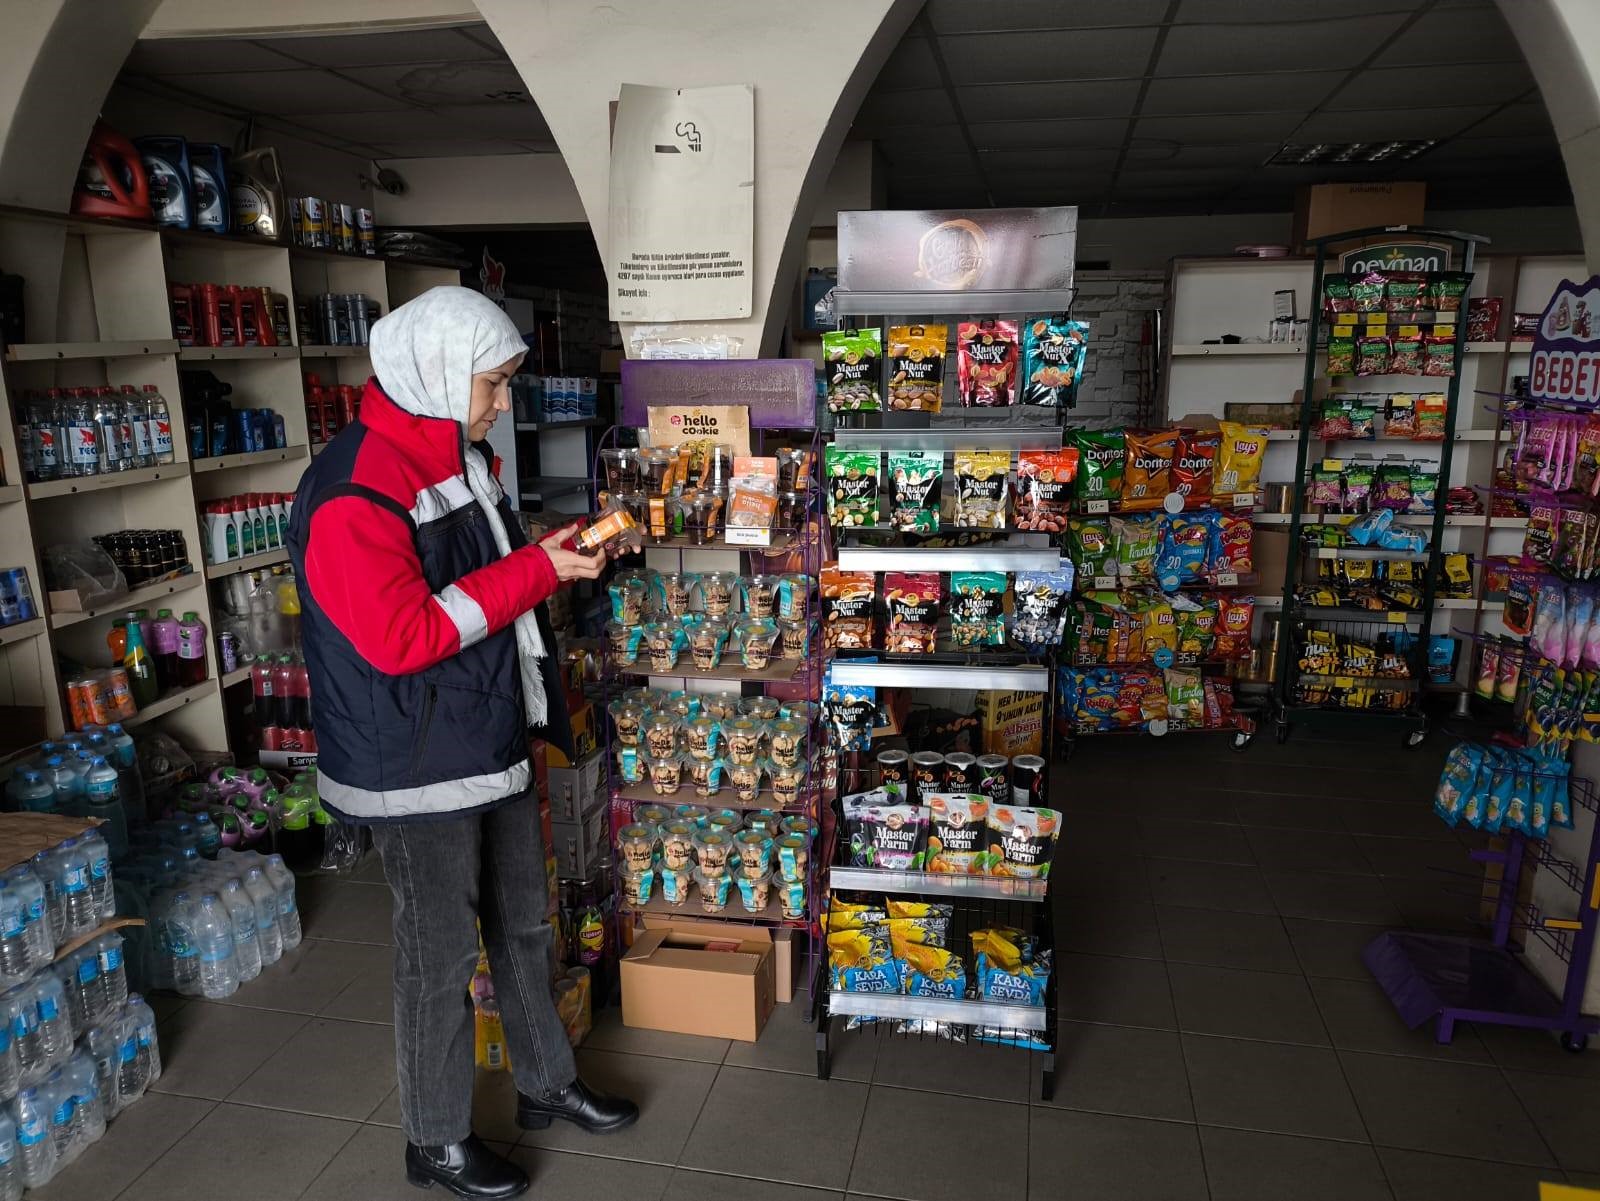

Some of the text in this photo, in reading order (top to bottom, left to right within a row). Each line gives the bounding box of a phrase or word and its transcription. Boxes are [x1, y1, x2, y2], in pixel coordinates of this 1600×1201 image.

[1352, 256, 1440, 273] peyman
[970, 344, 1006, 354] Master
[1038, 344, 1074, 354] Master
[836, 362, 869, 373] Master
[899, 360, 933, 372] Master
[846, 370, 862, 379] Nut
[908, 368, 925, 379] Nut
[1533, 356, 1600, 397] BEBET
[683, 414, 717, 426] hello
[682, 426, 719, 435] cookie
[1088, 449, 1125, 460] Doritos
[1180, 458, 1213, 468] Dorito
[1224, 470, 1238, 485] 20
[838, 479, 870, 490] Master
[965, 478, 998, 490] Master
[1088, 476, 1104, 492] 20
[1132, 484, 1146, 496] 20
[846, 487, 862, 496] Nut
[973, 487, 990, 496] Nut
[1038, 490, 1054, 500] Nut
[1081, 561, 1094, 576] 20
[1166, 556, 1182, 570] 20
[1218, 556, 1231, 570] 20
[832, 600, 864, 610] Master
[896, 604, 928, 615] Master
[840, 608, 855, 616] Nut
[904, 612, 920, 622] Nut
[1158, 613, 1174, 624] Lay
[1086, 696, 1115, 708] Ruffle
[834, 706, 864, 716] Master
[842, 713, 856, 722] Nut
[874, 827, 914, 842] Master
[938, 826, 978, 840] Master
[880, 838, 908, 850] Farm
[943, 838, 972, 850] Farm
[1000, 837, 1042, 854] Master
[1005, 848, 1035, 863] Farm
[854, 970, 886, 982] KARA
[994, 973, 1032, 990] KARA
[855, 980, 893, 992] SEVDA
[920, 978, 954, 992] KARA
[990, 984, 1032, 1001] SEVDA
